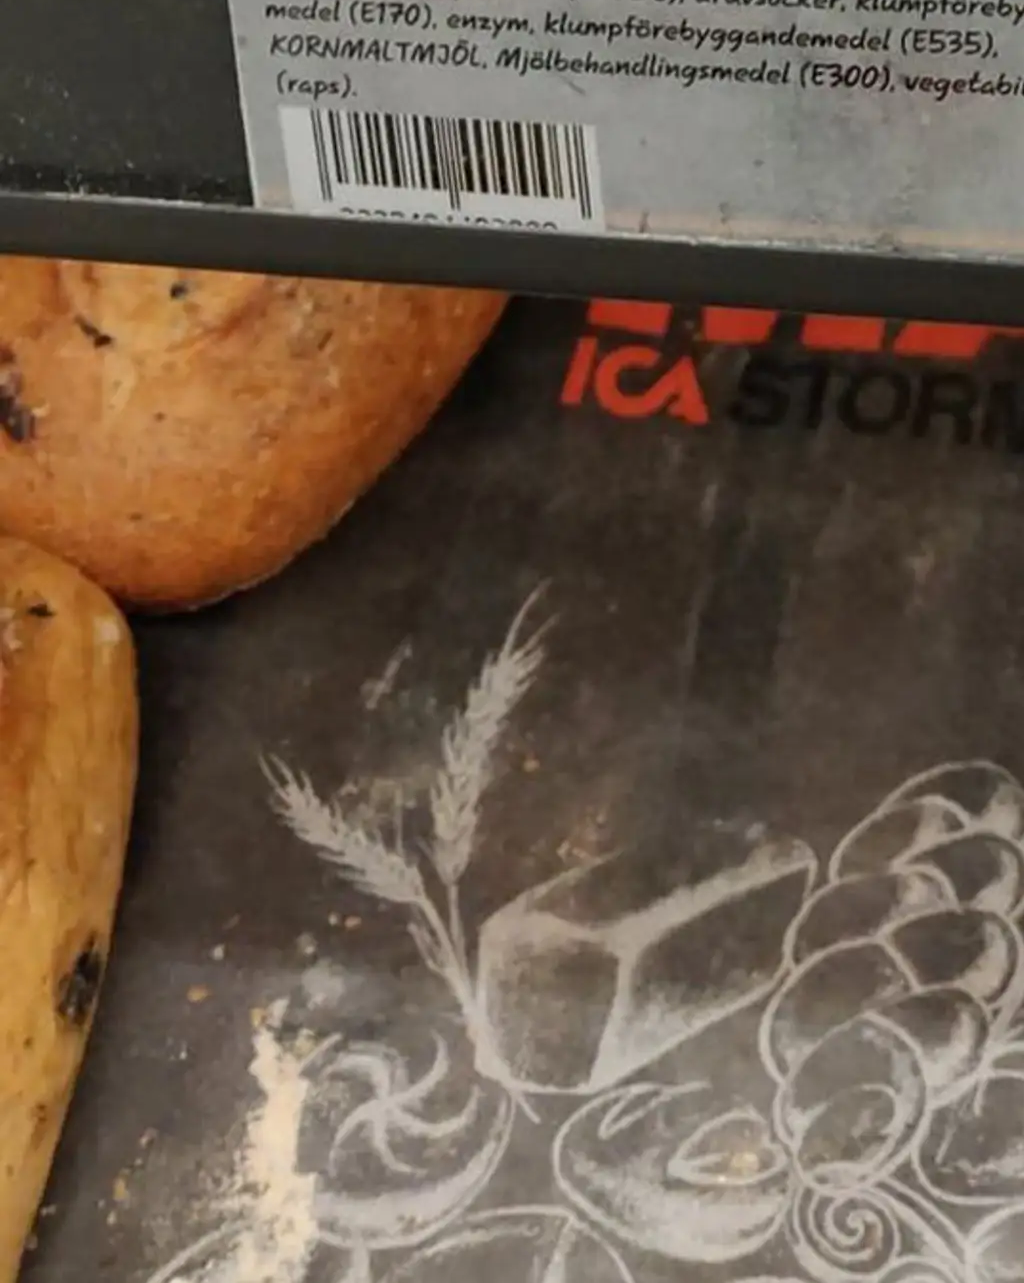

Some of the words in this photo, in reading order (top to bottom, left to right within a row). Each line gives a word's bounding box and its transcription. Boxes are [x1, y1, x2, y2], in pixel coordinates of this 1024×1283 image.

[265, 1, 340, 23] medel
[349, 3, 437, 32] (E170),
[446, 13, 535, 41] enzym,
[545, 12, 890, 57] klumpförebyggandemedel
[900, 27, 999, 59] (E535),
[269, 33, 488, 68] KORNMALTMJÖL,
[496, 46, 789, 86] Mjölbehandlingsmedel
[799, 62, 895, 93] (E300),
[276, 71, 358, 101] (raps).
[560, 336, 710, 425] ICA
